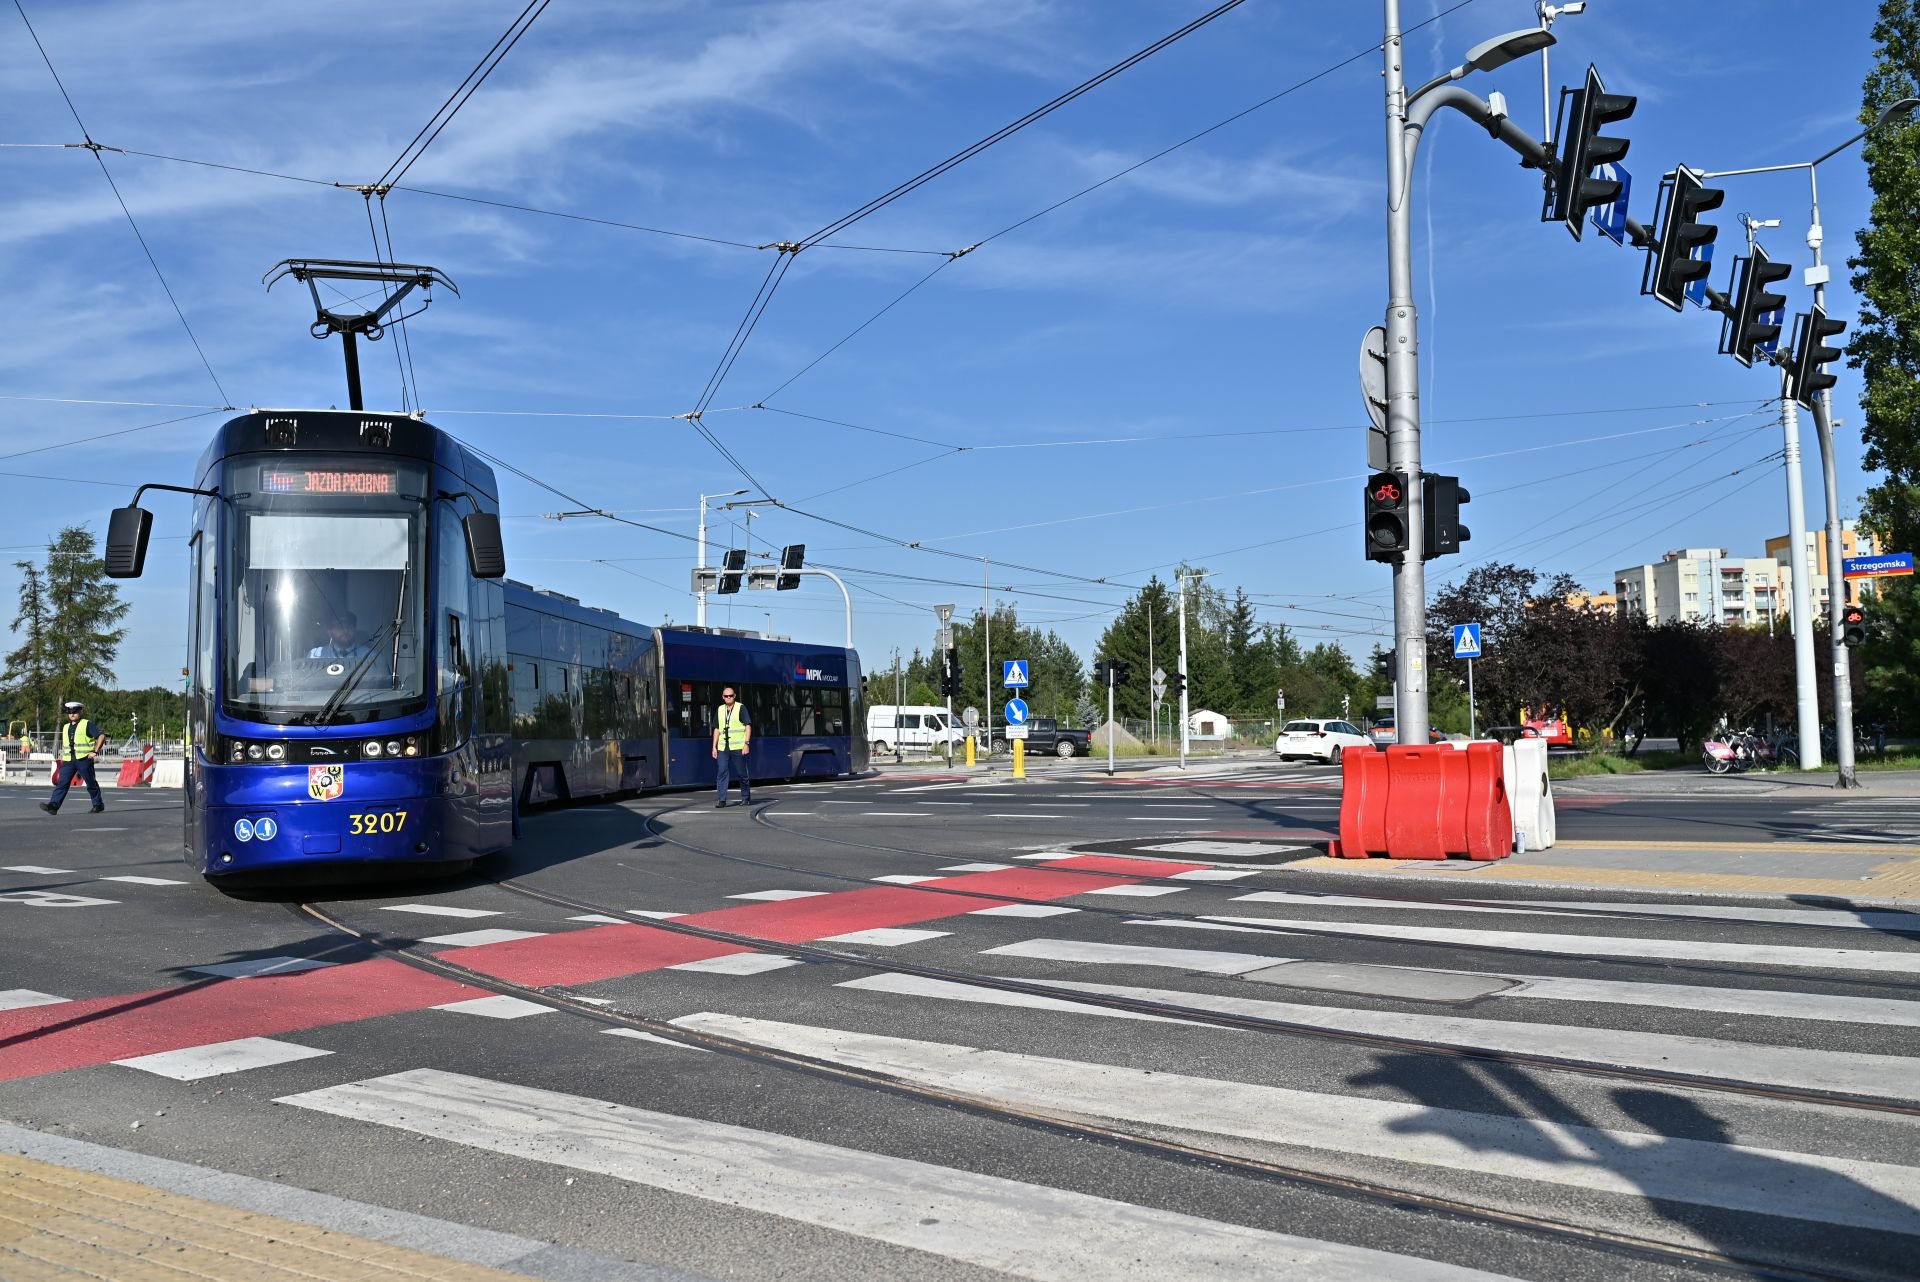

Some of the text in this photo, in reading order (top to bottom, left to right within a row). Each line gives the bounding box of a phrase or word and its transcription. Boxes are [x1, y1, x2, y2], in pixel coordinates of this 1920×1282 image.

[304, 472, 341, 491] JAZDA
[1850, 560, 1906, 571] Strzegomska
[806, 668, 822, 681] MPK
[349, 811, 408, 835] 3207
